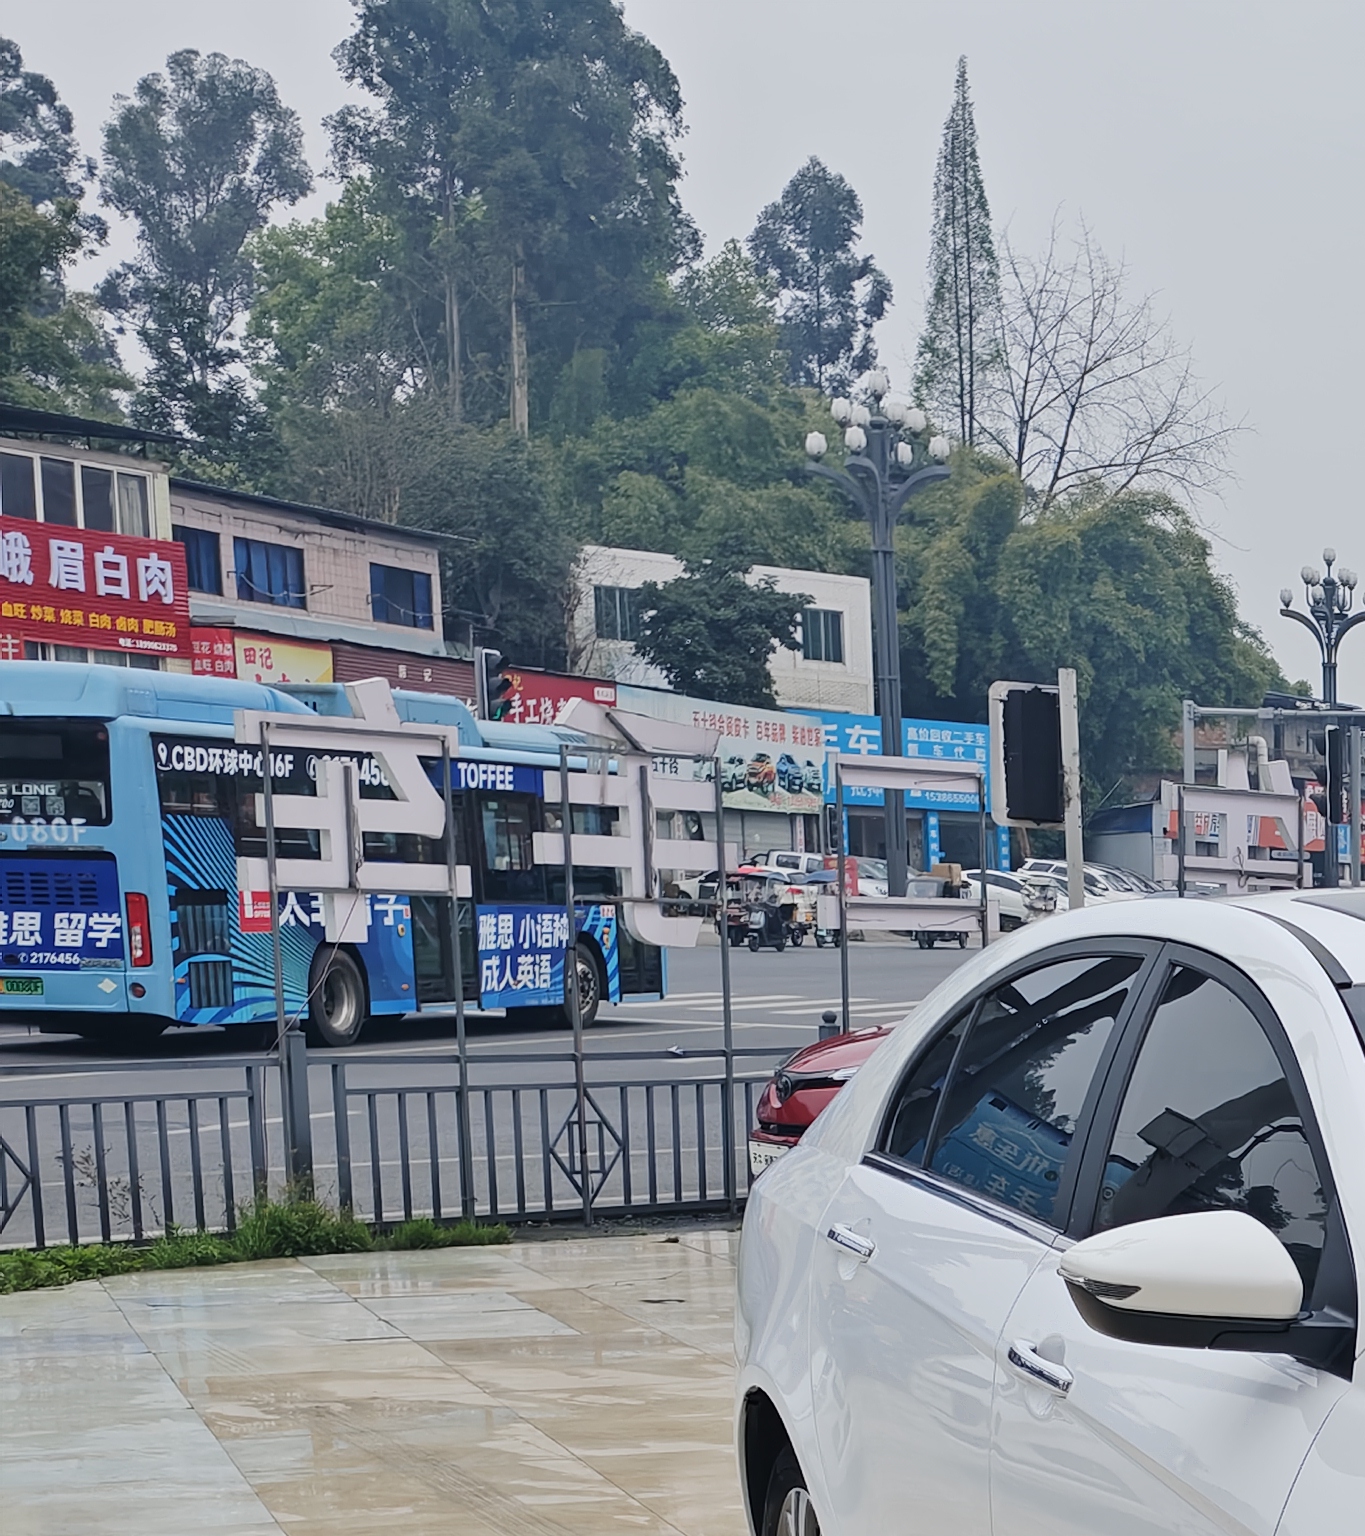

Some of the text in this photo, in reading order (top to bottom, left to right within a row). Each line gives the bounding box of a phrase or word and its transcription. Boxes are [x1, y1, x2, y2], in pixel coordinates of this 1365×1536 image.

[0, 530, 175, 605] 峨眉白肉
[88, 613, 112, 630] 白肉
[12, 784, 57, 795] LONG
[457, 762, 514, 791] TOFFEE
[53, 912, 122, 948] 留学
[478, 913, 570, 950] 雅思 小语种
[30, 953, 80, 965] 2176456
[481, 954, 552, 993] 成人英语
